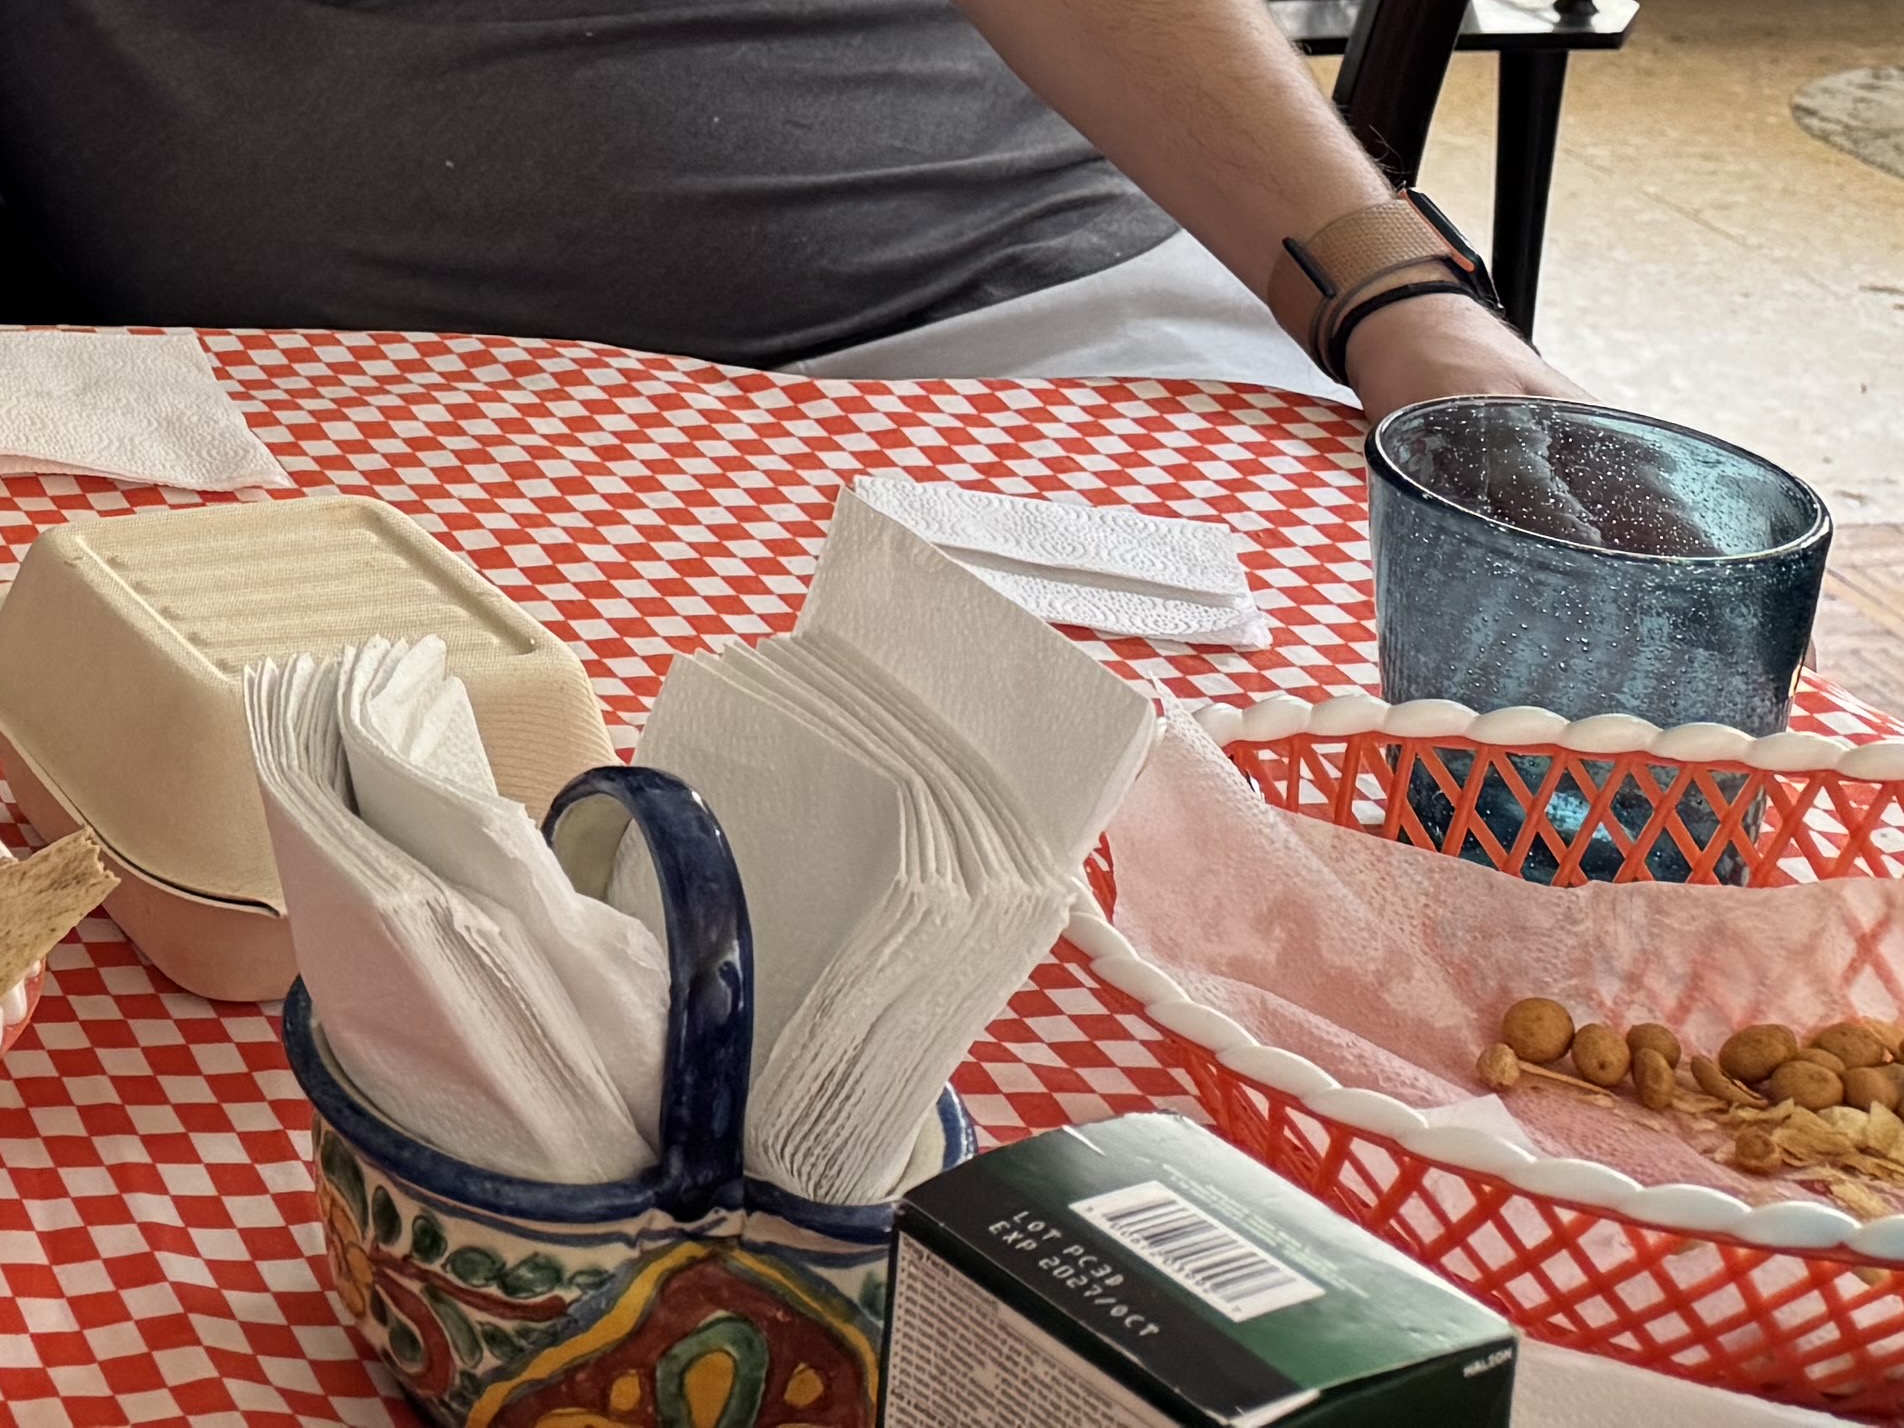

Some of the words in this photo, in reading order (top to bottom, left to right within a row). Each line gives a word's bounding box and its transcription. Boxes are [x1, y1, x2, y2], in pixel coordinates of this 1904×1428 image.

[1013, 1211, 1062, 1241] LOT
[989, 1221, 1037, 1251] EXP
[1038, 1256, 1160, 1336] 2027/OCT
